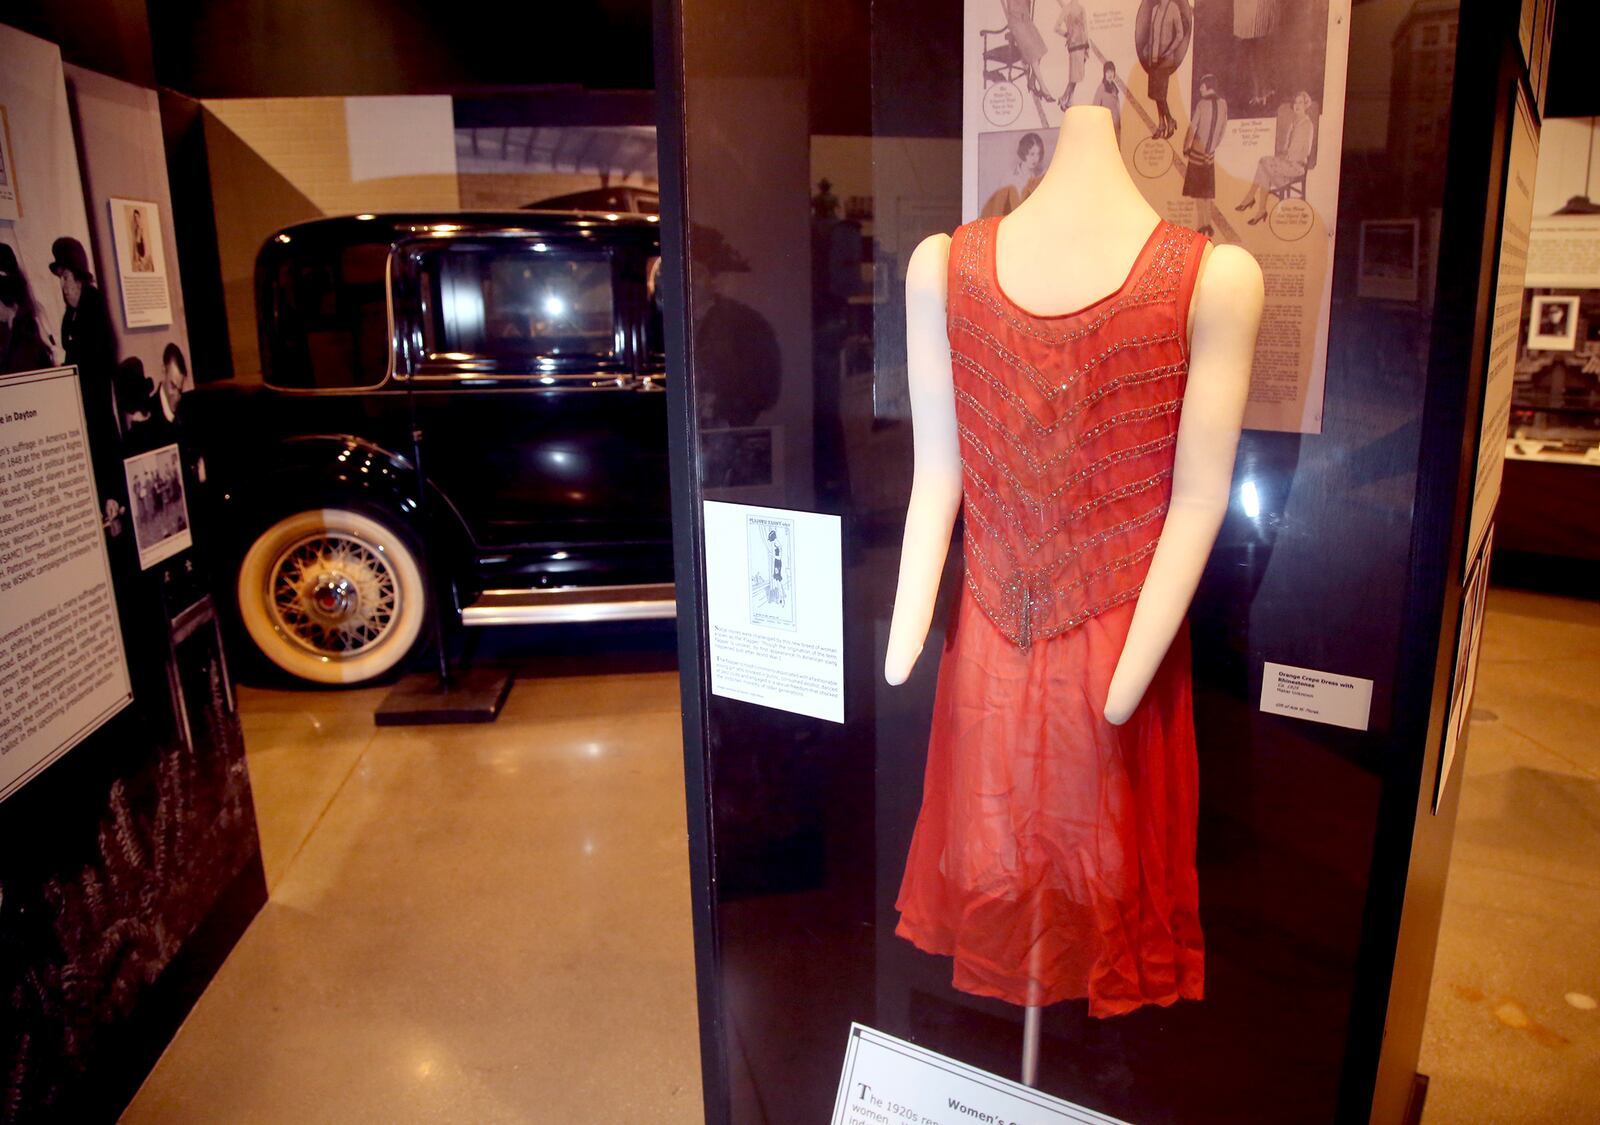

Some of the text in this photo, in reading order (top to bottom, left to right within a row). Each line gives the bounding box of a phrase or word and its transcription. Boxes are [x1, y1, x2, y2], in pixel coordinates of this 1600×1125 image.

[14, 410, 36, 421] Dayton
[13, 440, 35, 453] suffrage
[46, 432, 67, 443] America
[8, 457, 21, 466] 1848
[15, 467, 34, 478] hotbed
[44, 458, 65, 470] political
[24, 478, 44, 490] against
[46, 471, 64, 482] slavery
[32, 485, 55, 499] Suffrage
[16, 504, 36, 517] formed
[4, 523, 24, 535] several
[26, 514, 48, 526] decades
[42, 520, 63, 534] Suffrage
[31, 613, 46, 626] World
[34, 627, 46, 639] their
[29, 641, 42, 655] after
[21, 658, 38, 674] began
[33, 656, 65, 678] Amendment
[1279, 671, 1300, 680] Orange
[1278, 678, 1315, 688] Rhinestones
[12, 706, 26, 720] born
[858, 1082, 883, 1108] The
[887, 1101, 918, 1122] 1920s
[948, 1098, 1004, 1125] Women's
